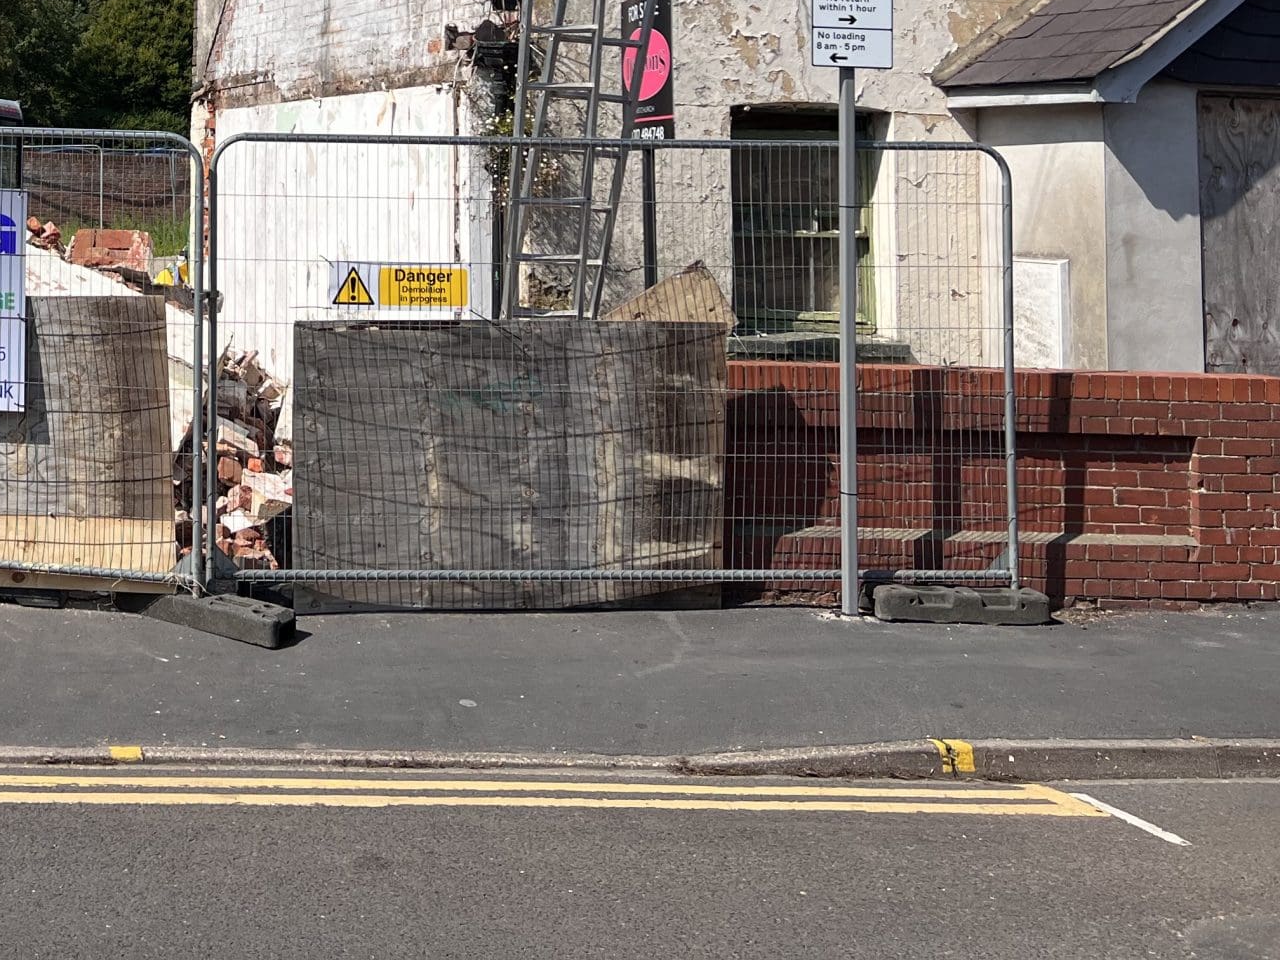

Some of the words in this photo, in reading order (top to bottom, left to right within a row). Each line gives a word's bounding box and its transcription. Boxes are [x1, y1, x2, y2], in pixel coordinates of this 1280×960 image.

[818, 3, 847, 12] within
[856, 4, 877, 13] hour
[817, 31, 831, 39] No
[833, 32, 866, 42] loading
[816, 41, 823, 50] 8
[824, 42, 838, 50] am
[844, 42, 850, 51] 5
[851, 44, 866, 52] pm
[394, 268, 453, 285] Danger
[402, 285, 446, 294] Demolition
[409, 295, 448, 304] progress
